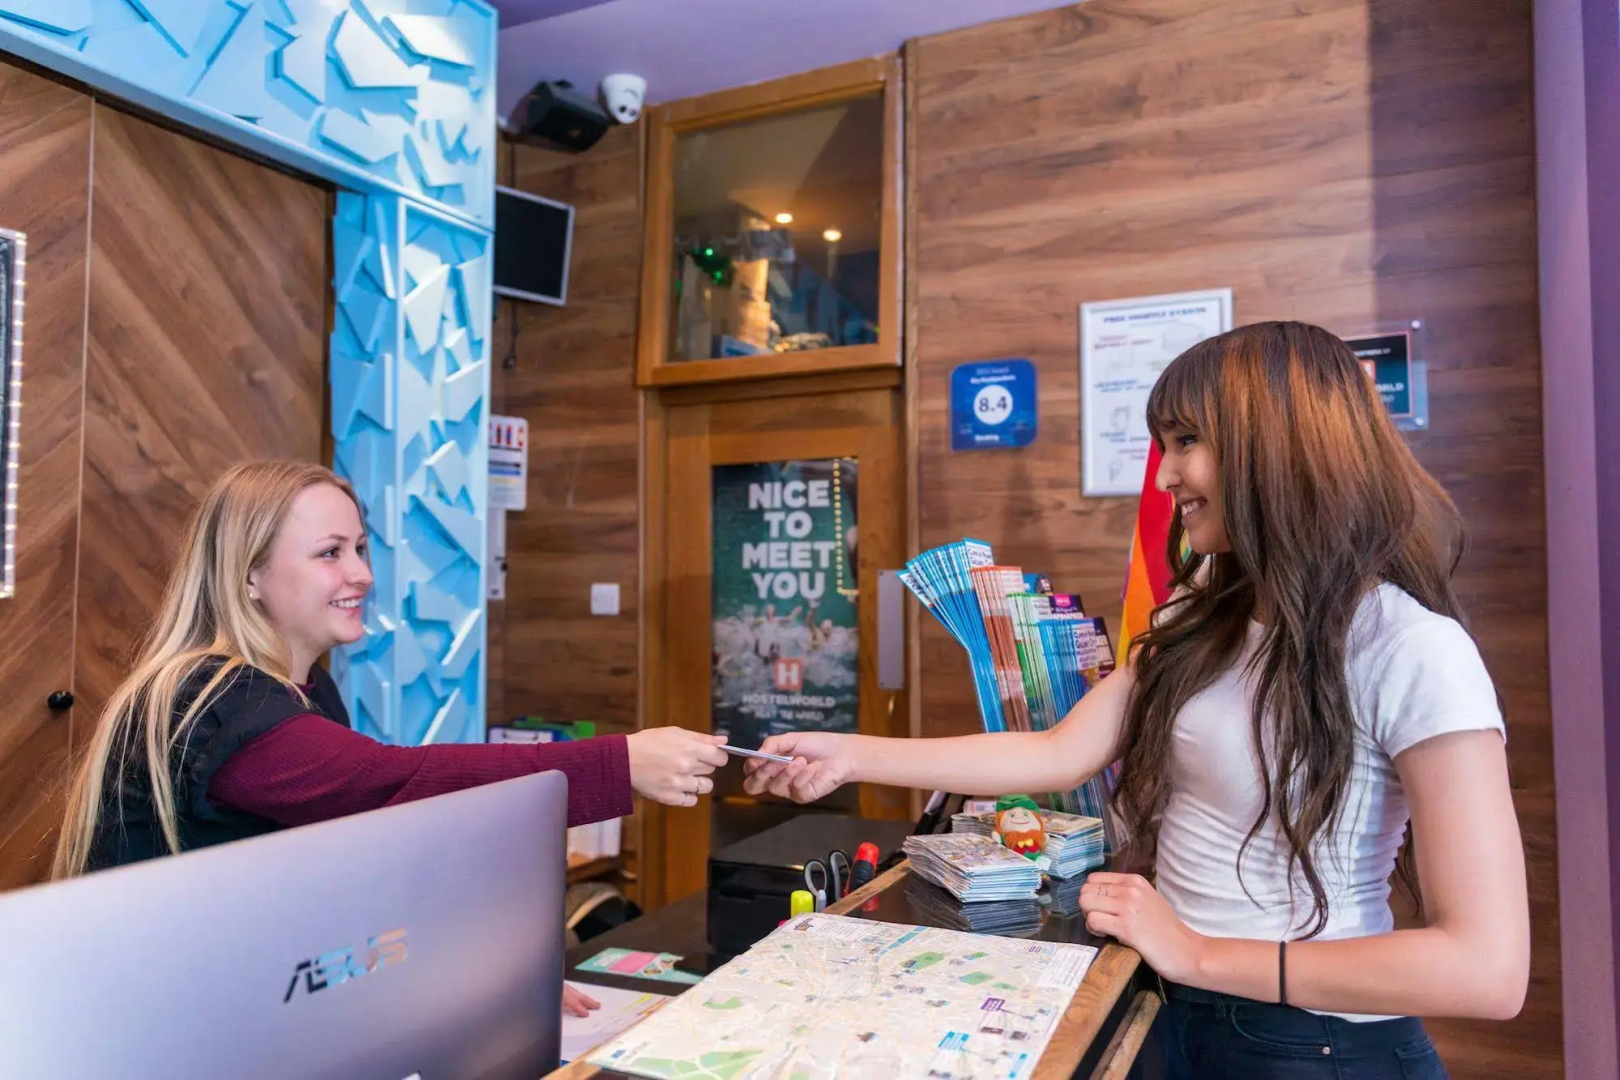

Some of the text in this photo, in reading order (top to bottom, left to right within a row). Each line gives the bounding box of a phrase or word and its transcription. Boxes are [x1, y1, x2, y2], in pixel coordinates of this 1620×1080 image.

[978, 396, 1008, 412] 8.4
[748, 479, 830, 510] NICE
[763, 510, 813, 539] TO
[742, 540, 836, 570] MEET
[752, 571, 826, 600] YOU
[776, 662, 800, 686] H
[742, 693, 836, 708] HOSTELWORLD
[283, 926, 408, 1004] ASUS
